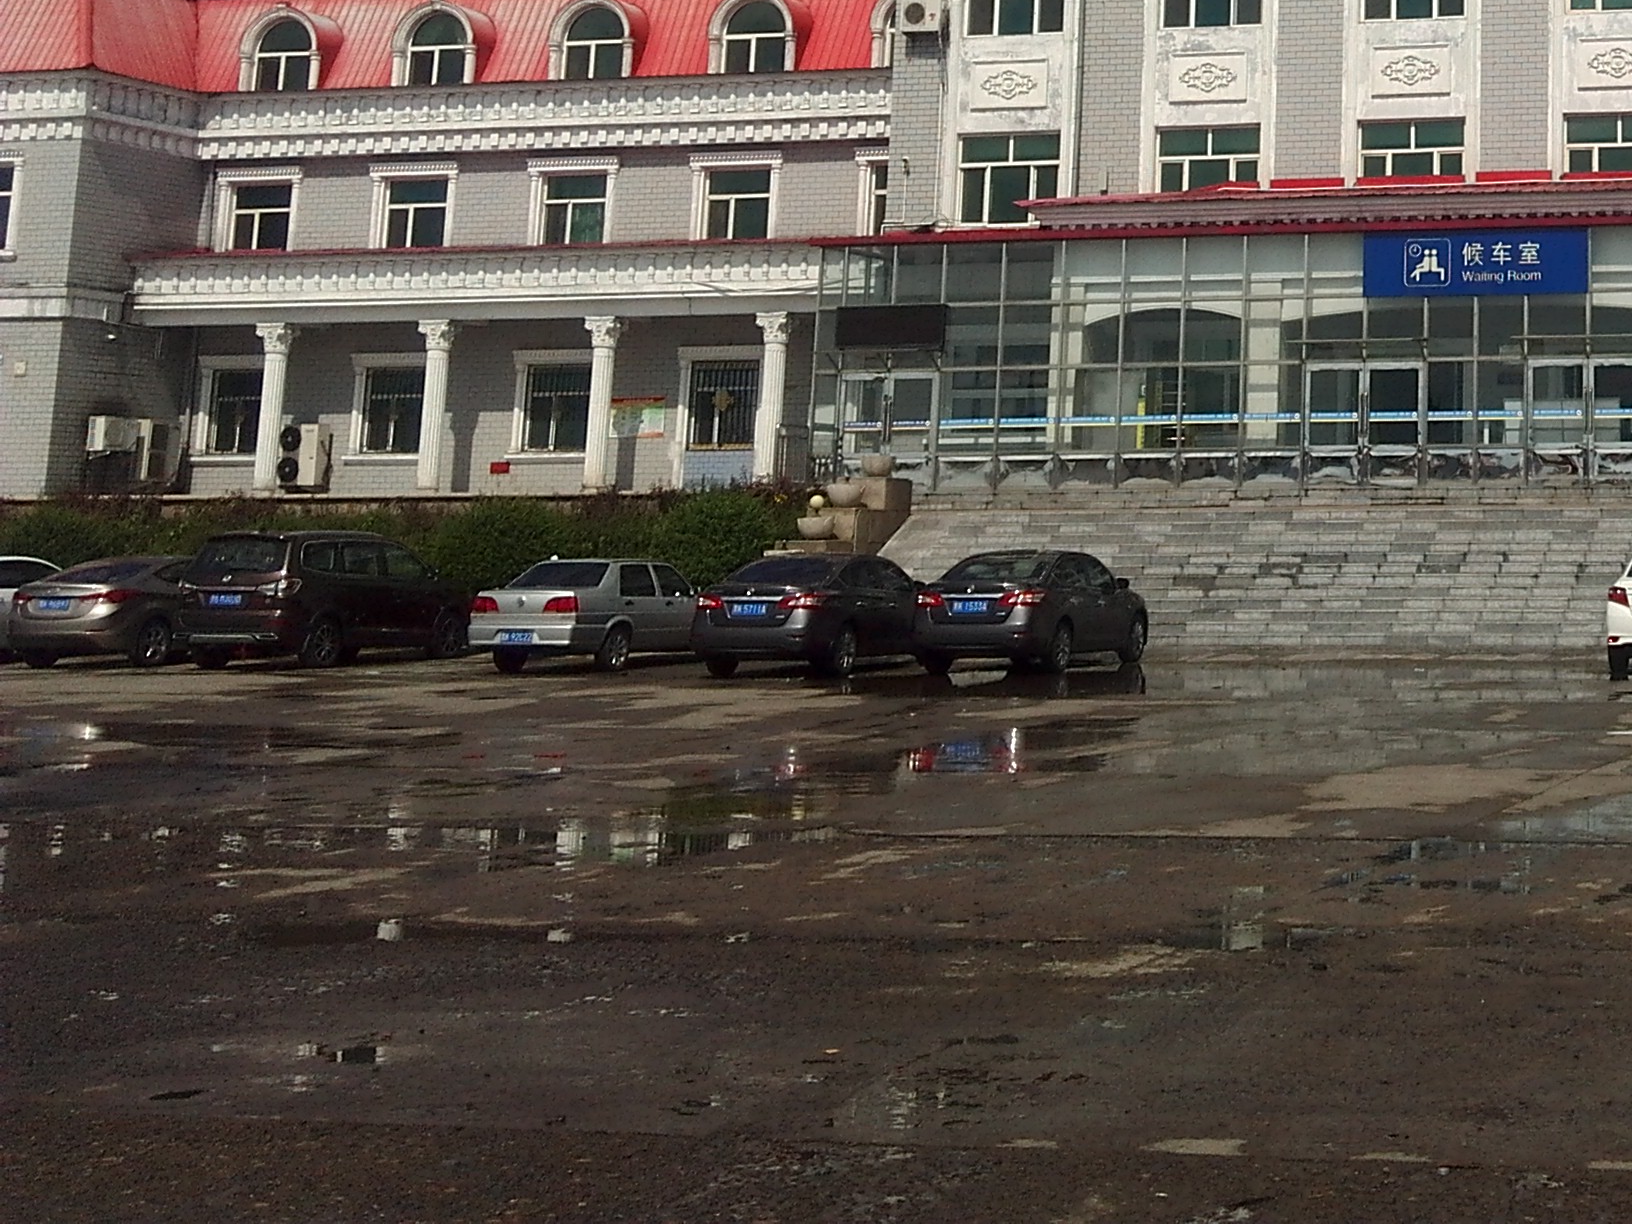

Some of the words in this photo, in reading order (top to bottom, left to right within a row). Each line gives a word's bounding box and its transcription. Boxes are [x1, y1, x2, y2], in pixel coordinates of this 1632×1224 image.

[1461, 241, 1541, 266] 候车室
[1461, 270, 1505, 284] Waiting
[1507, 269, 1542, 282] Room
